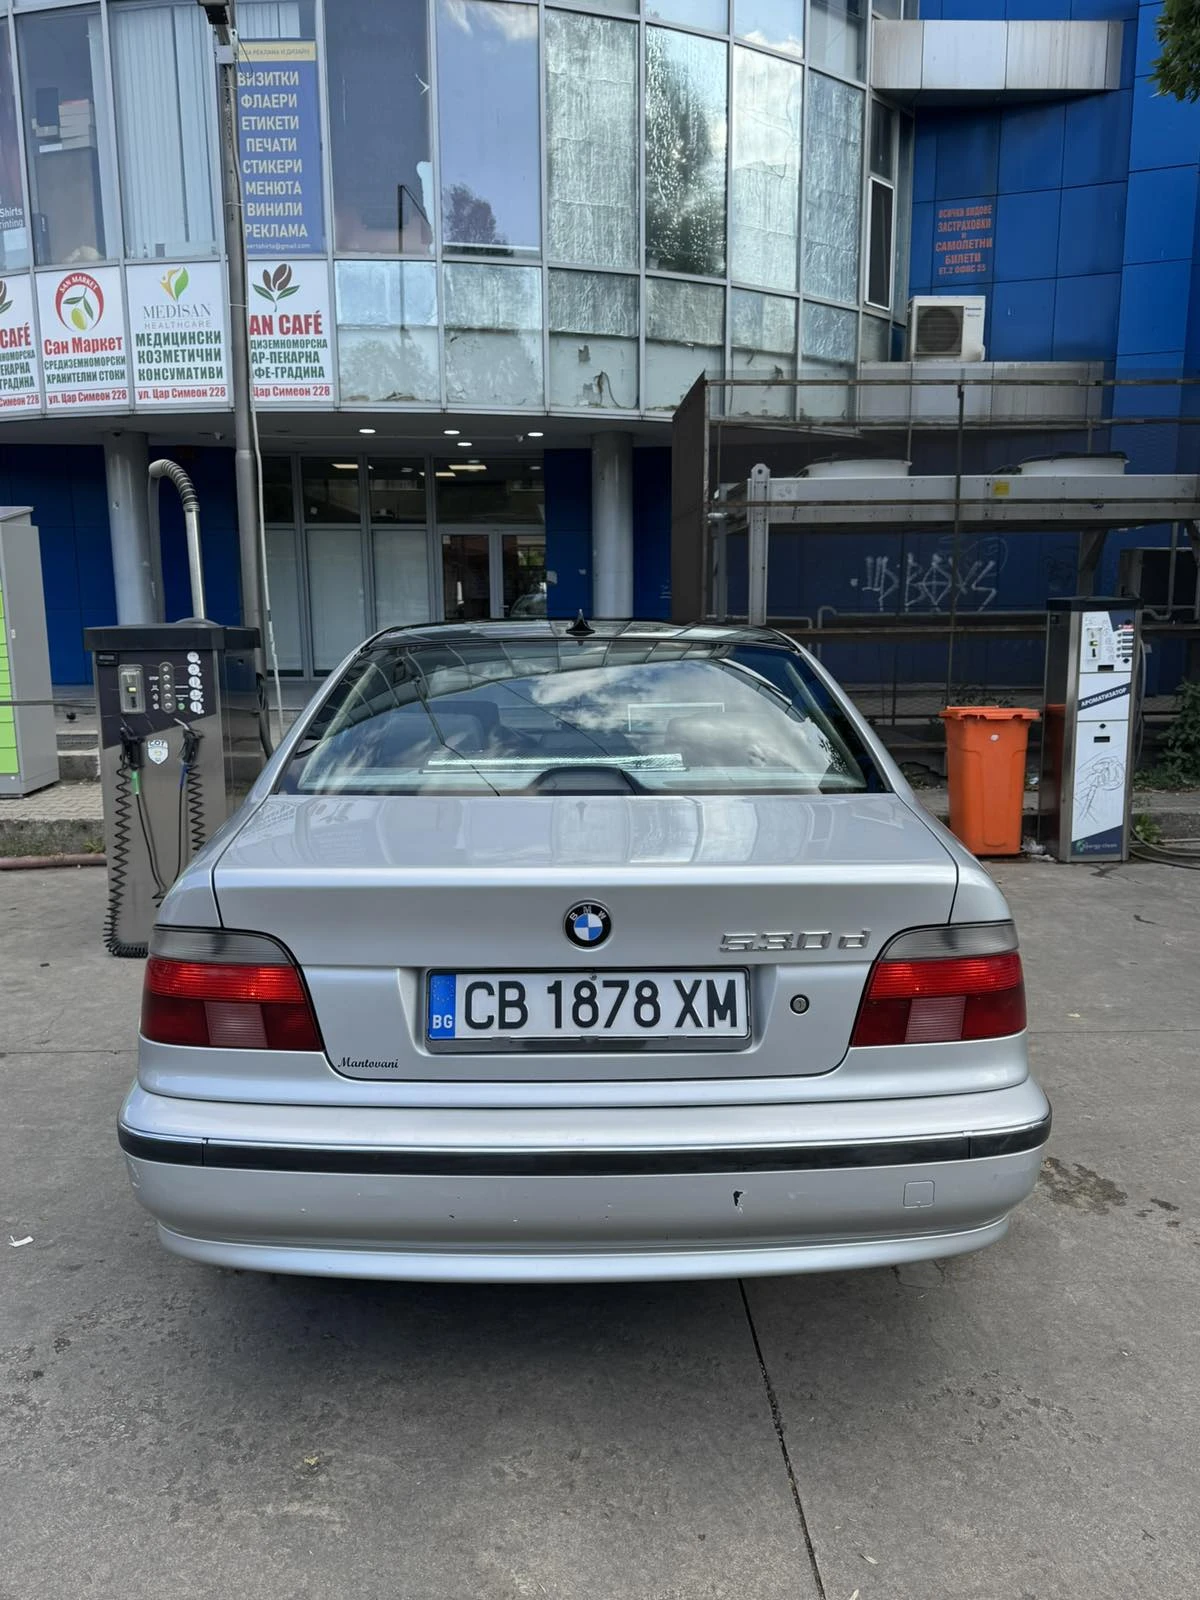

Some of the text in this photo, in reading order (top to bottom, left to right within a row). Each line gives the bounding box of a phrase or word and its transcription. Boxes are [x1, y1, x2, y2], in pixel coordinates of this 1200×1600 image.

[237, 71, 299, 87] ВИЗИТКИ
[241, 93, 298, 109] ФЛАЕРИ
[241, 115, 299, 131] ЕТИКЕТИ
[246, 137, 297, 152] ПЕЧАТИ
[243, 159, 303, 174] СТИКЕРИ
[245, 181, 302, 195] МЕНЮТА
[247, 202, 303, 216] ВИНИЛИ
[245, 223, 308, 238] РЕКЛАМА
[938, 219, 991, 232] ЗАСТРАХОВКИ
[936, 239, 992, 252] САМОЛЕТНИ
[945, 253, 981, 264] БИЛЕТИ
[71, 275, 98, 290] MARKET
[143, 303, 211, 319] MEDISAN
[144, 320, 213, 330] HEALTHCARE
[278, 310, 323, 335] CAFÉ
[0, 322, 31, 349] CAFÉ
[135, 330, 222, 348] МЕДИЦИНСКИ
[44, 336, 122, 355] Сан Маркет
[44, 355, 126, 370] СРЕДИЗЕМНОМОРСКИ
[137, 348, 222, 364] КОЗМЕТИЧНИ
[46, 369, 126, 384] ХРАНИТЕЛНИ СТОКИ
[138, 366, 223, 381] КОНСУМАТИВИ
[253, 366, 325, 380] ФЕ-ГРАДИНА
[48, 389, 127, 404] ул. Цар Симеон 228
[138, 386, 226, 400] ул. Цар Симеон 228
[272, 386, 310, 397] Симеон
[312, 385, 330, 397] 228
[26, 394, 40, 405] 228
[1080, 687, 1127, 707] АРОМАТИЗАТОР
[569, 905, 607, 921] BMW
[432, 978, 738, 1030] BG CB 1878 XM
[337, 1056, 399, 1069] Mantovani
